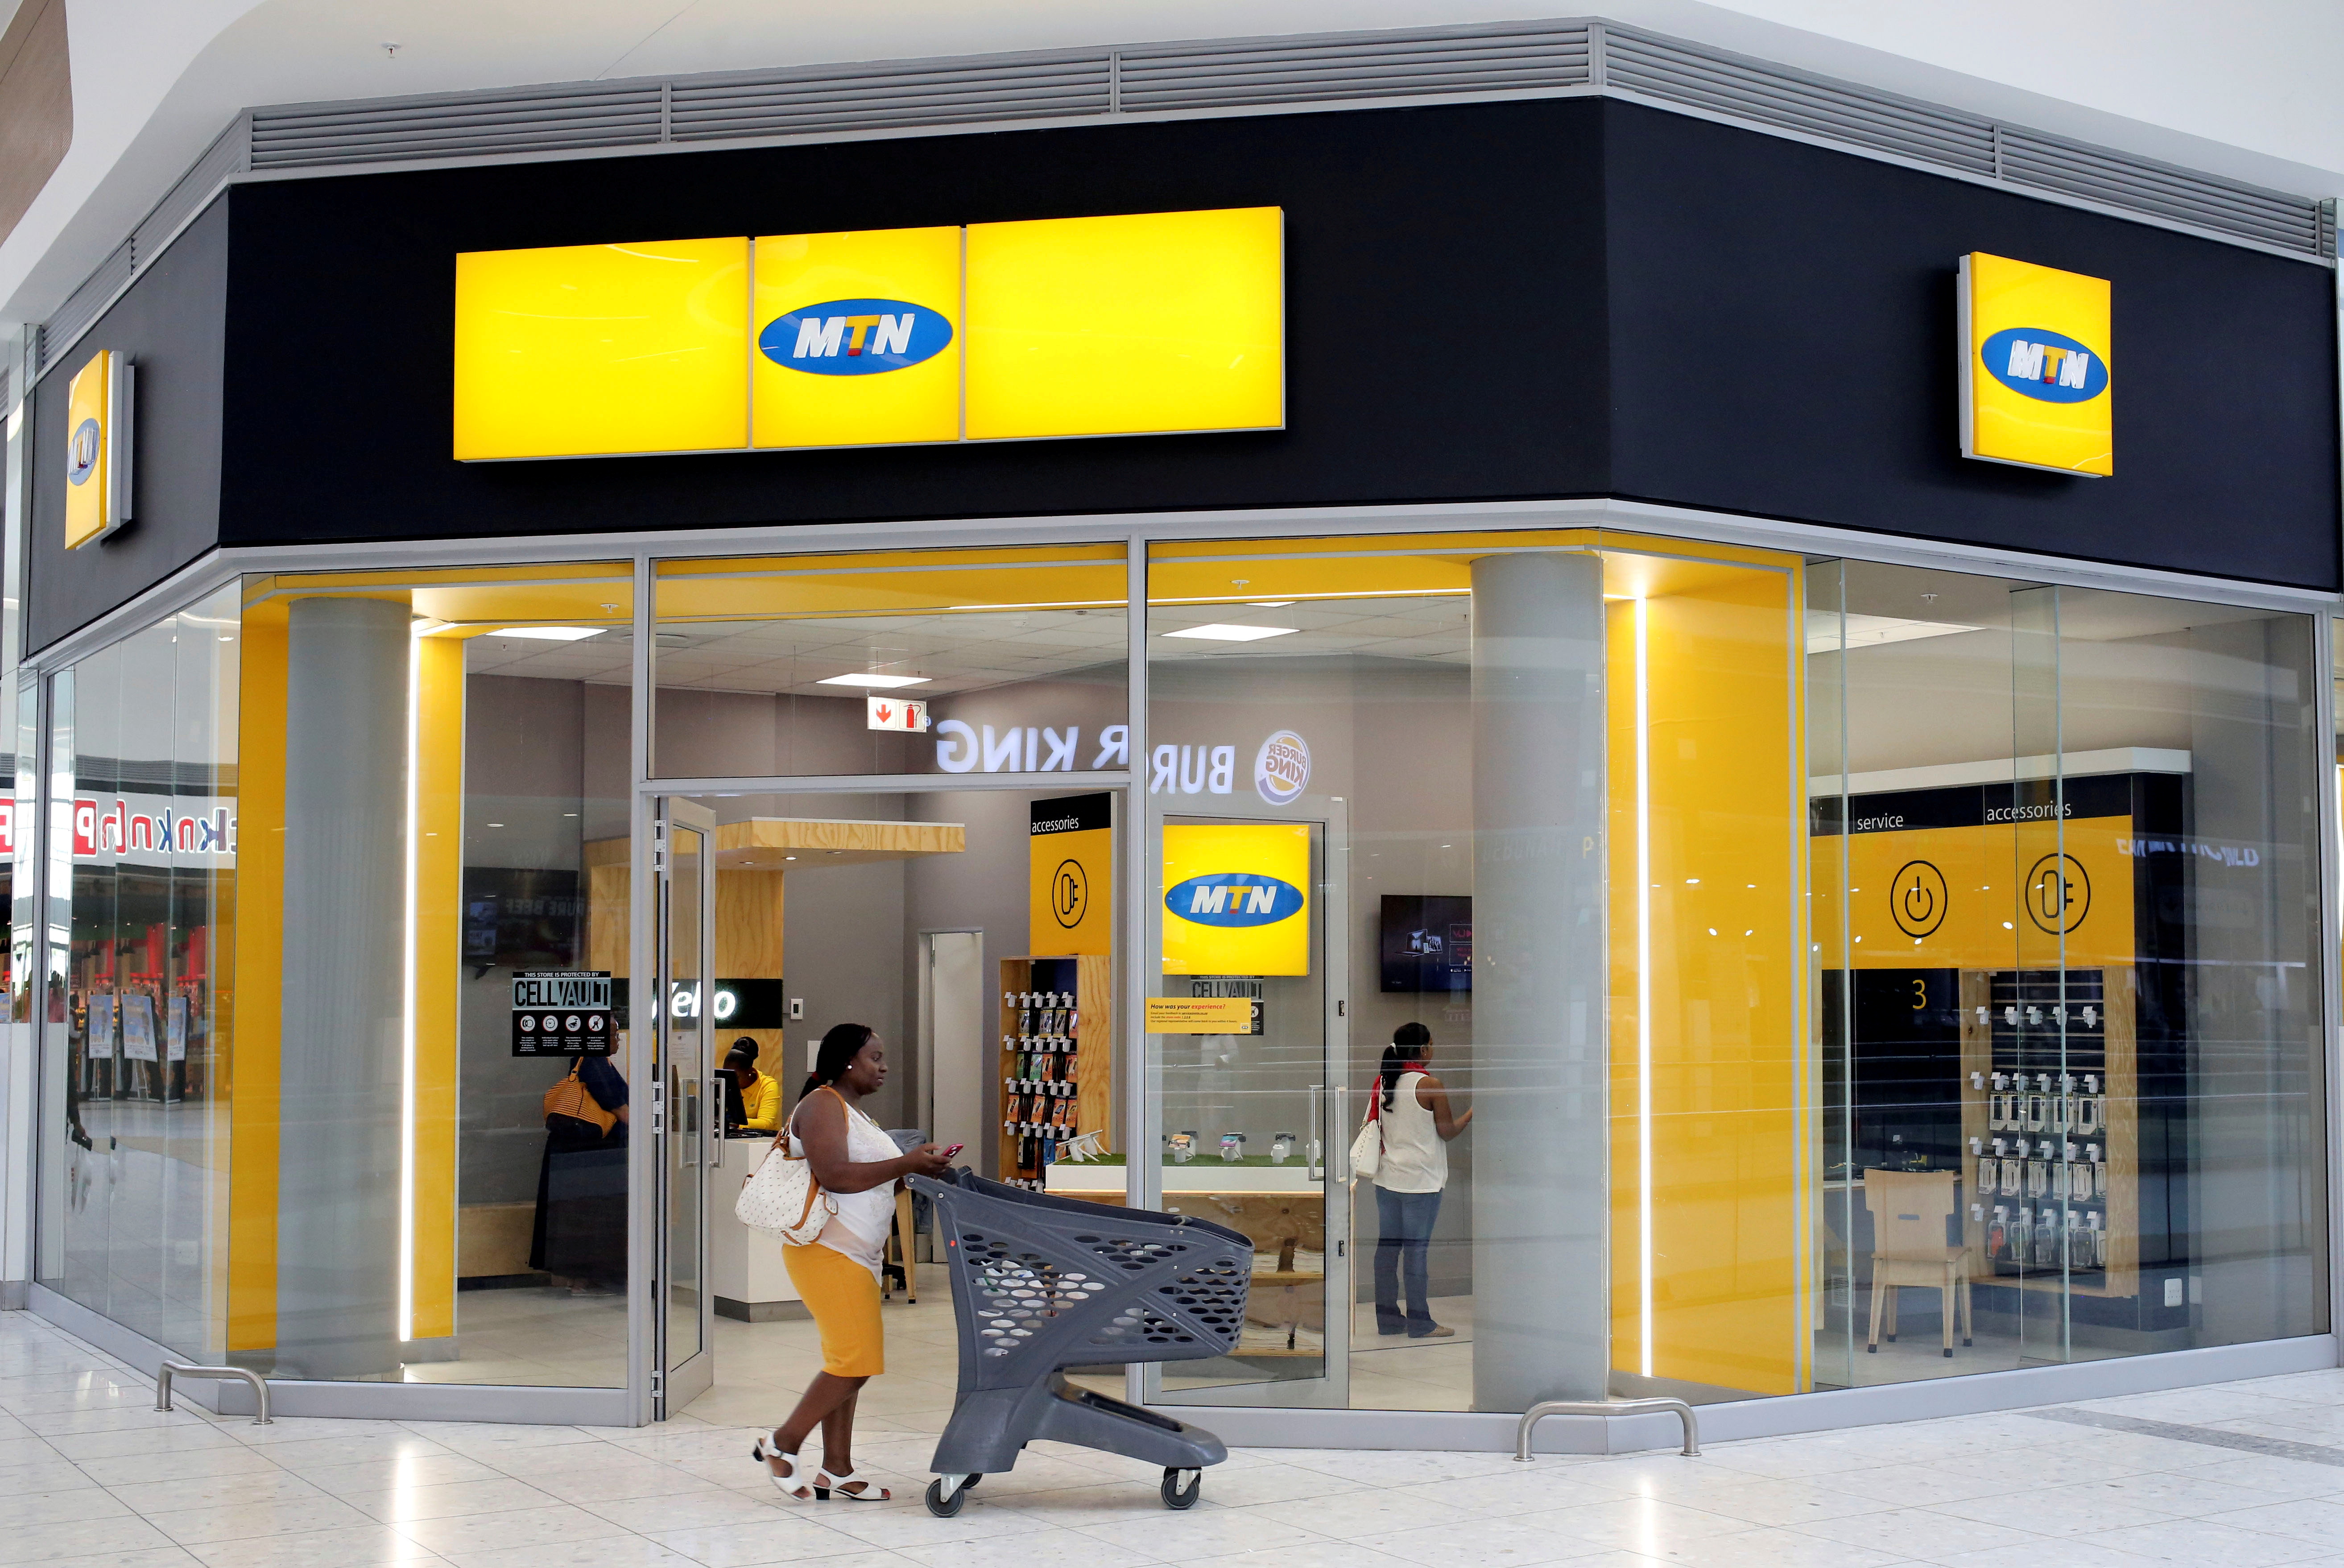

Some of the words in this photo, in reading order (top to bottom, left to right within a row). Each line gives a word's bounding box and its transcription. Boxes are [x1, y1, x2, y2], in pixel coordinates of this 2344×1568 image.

[793, 313, 915, 358] MTN
[2007, 339, 2089, 390] MTN
[1032, 815, 1079, 833] accessories
[1857, 813, 1904, 831] service
[1986, 801, 2072, 821] accessories
[1190, 885, 1277, 914] MTN
[1913, 980, 1926, 1010] 3
